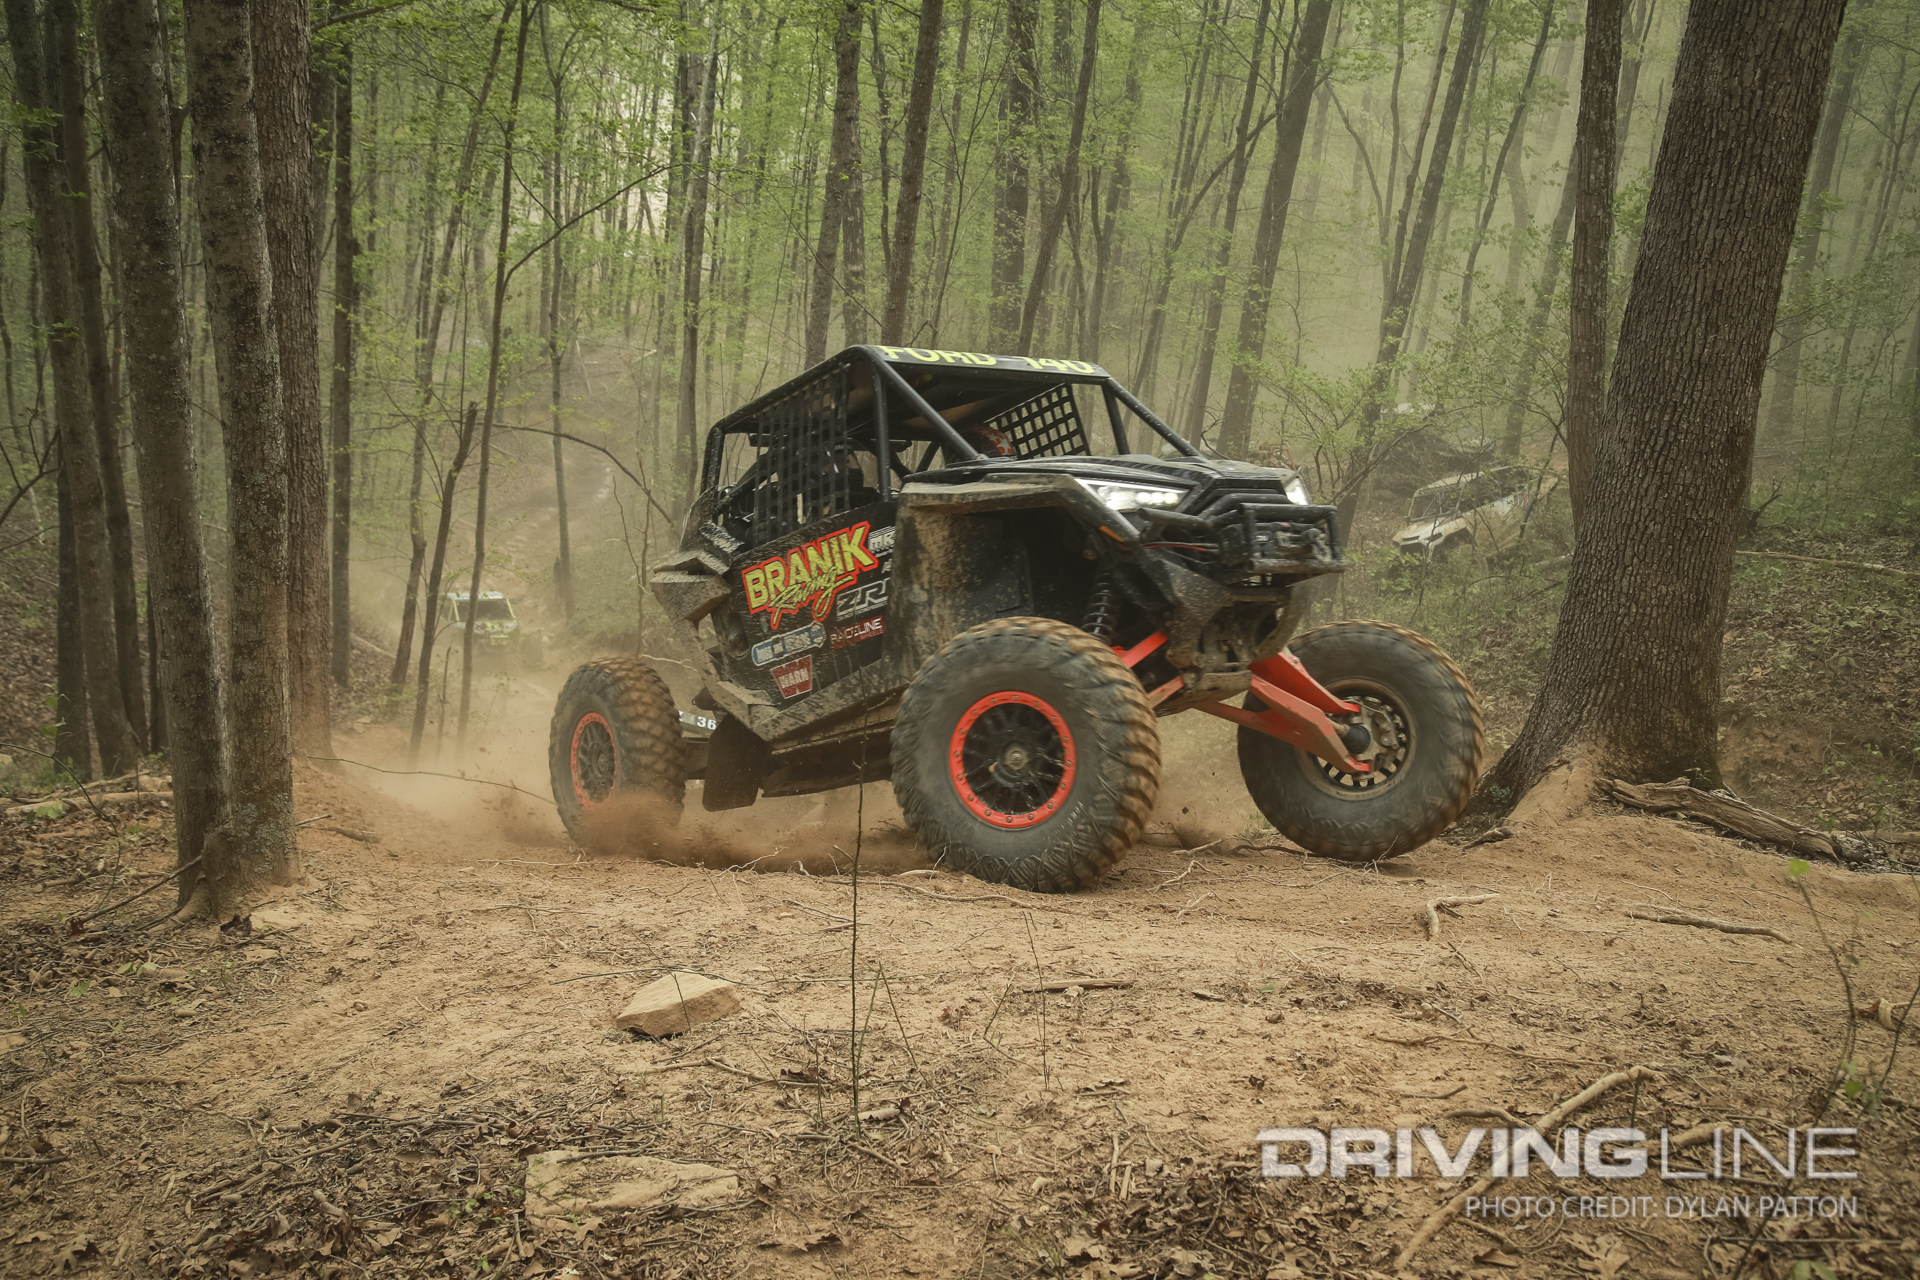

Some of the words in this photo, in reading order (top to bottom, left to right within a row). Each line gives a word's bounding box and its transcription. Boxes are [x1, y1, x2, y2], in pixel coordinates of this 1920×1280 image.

[876, 345, 997, 366] FORD
[744, 525, 875, 610] BRANIK
[830, 617, 883, 645] RACELINE
[778, 667, 810, 689] WARN
[696, 716, 718, 731] 36
